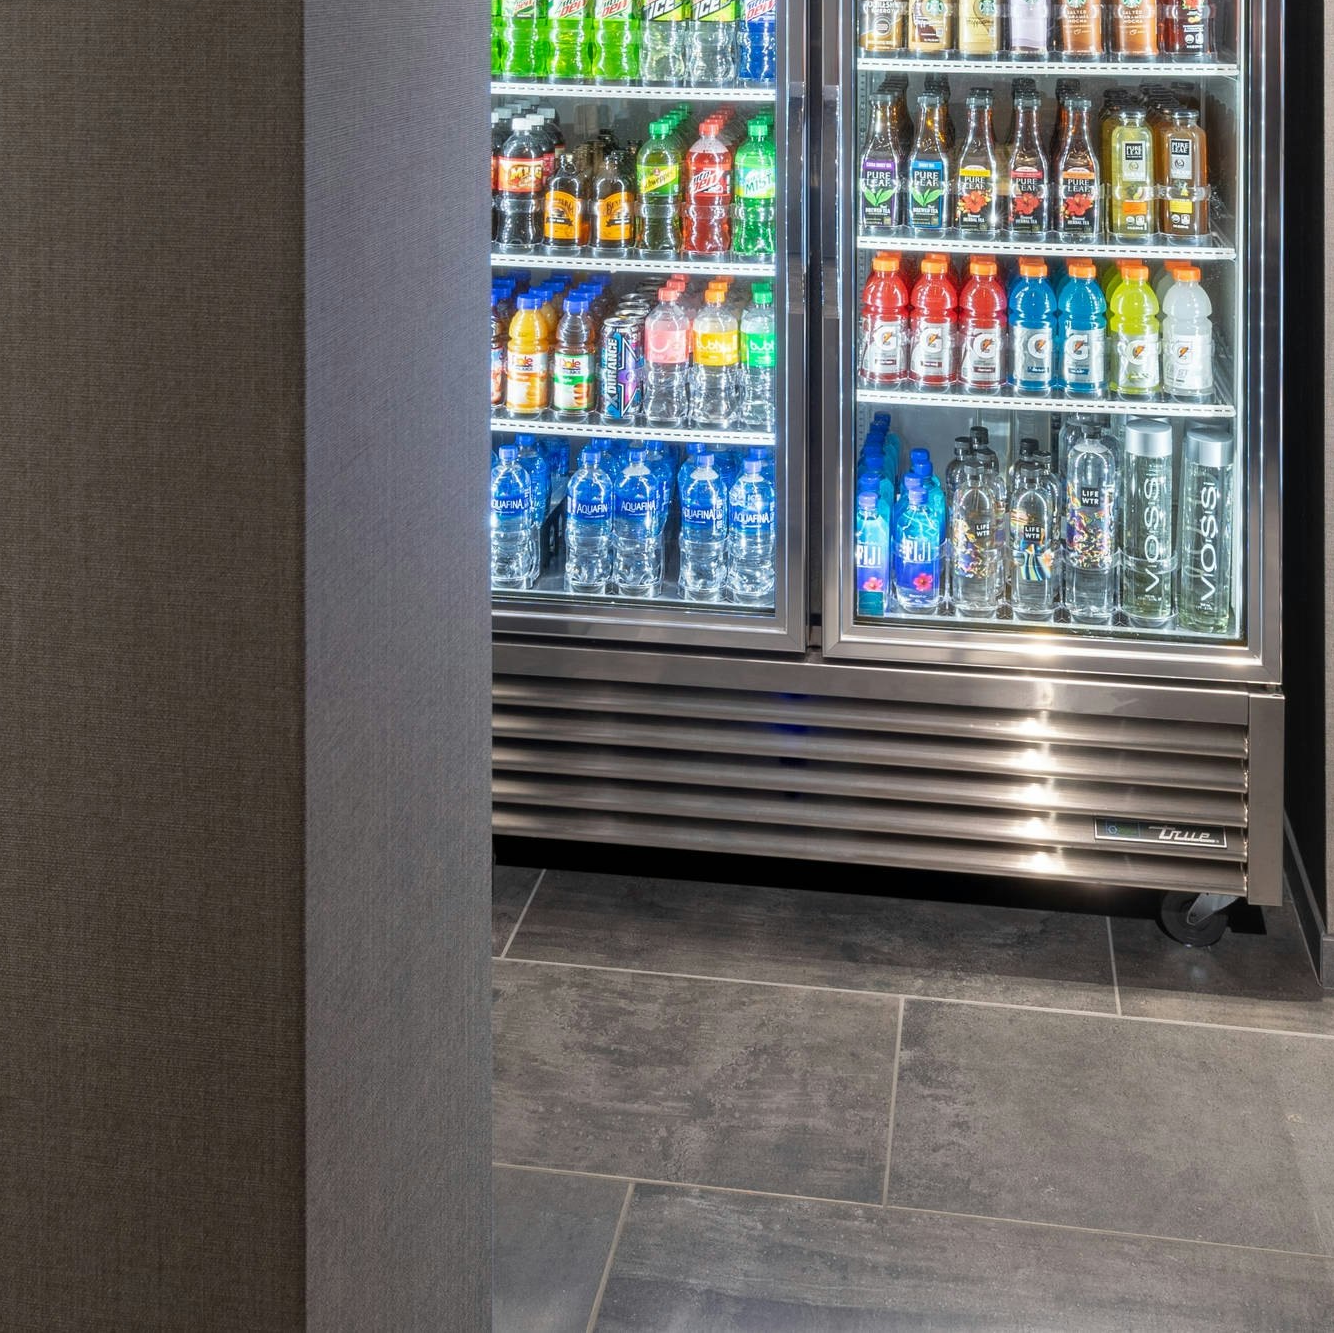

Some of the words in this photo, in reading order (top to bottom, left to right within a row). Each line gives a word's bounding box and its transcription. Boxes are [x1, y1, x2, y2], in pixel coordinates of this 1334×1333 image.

[866, 170, 891, 179] PURE
[914, 170, 939, 180] PURE
[964, 175, 986, 184] PURE
[1015, 177, 1038, 186] PURE
[1067, 178, 1090, 186] PURE
[1017, 184, 1038, 192] EAF
[750, 339, 775, 352] bubl
[1081, 490, 1099, 498] LIFE
[491, 497, 525, 512] QUAFINA
[1081, 497, 1099, 505] WTR
[576, 503, 608, 516] AQUAFIN
[976, 523, 990, 531] LIFE
[857, 544, 882, 566] FIJI
[905, 539, 932, 563] FIJI
